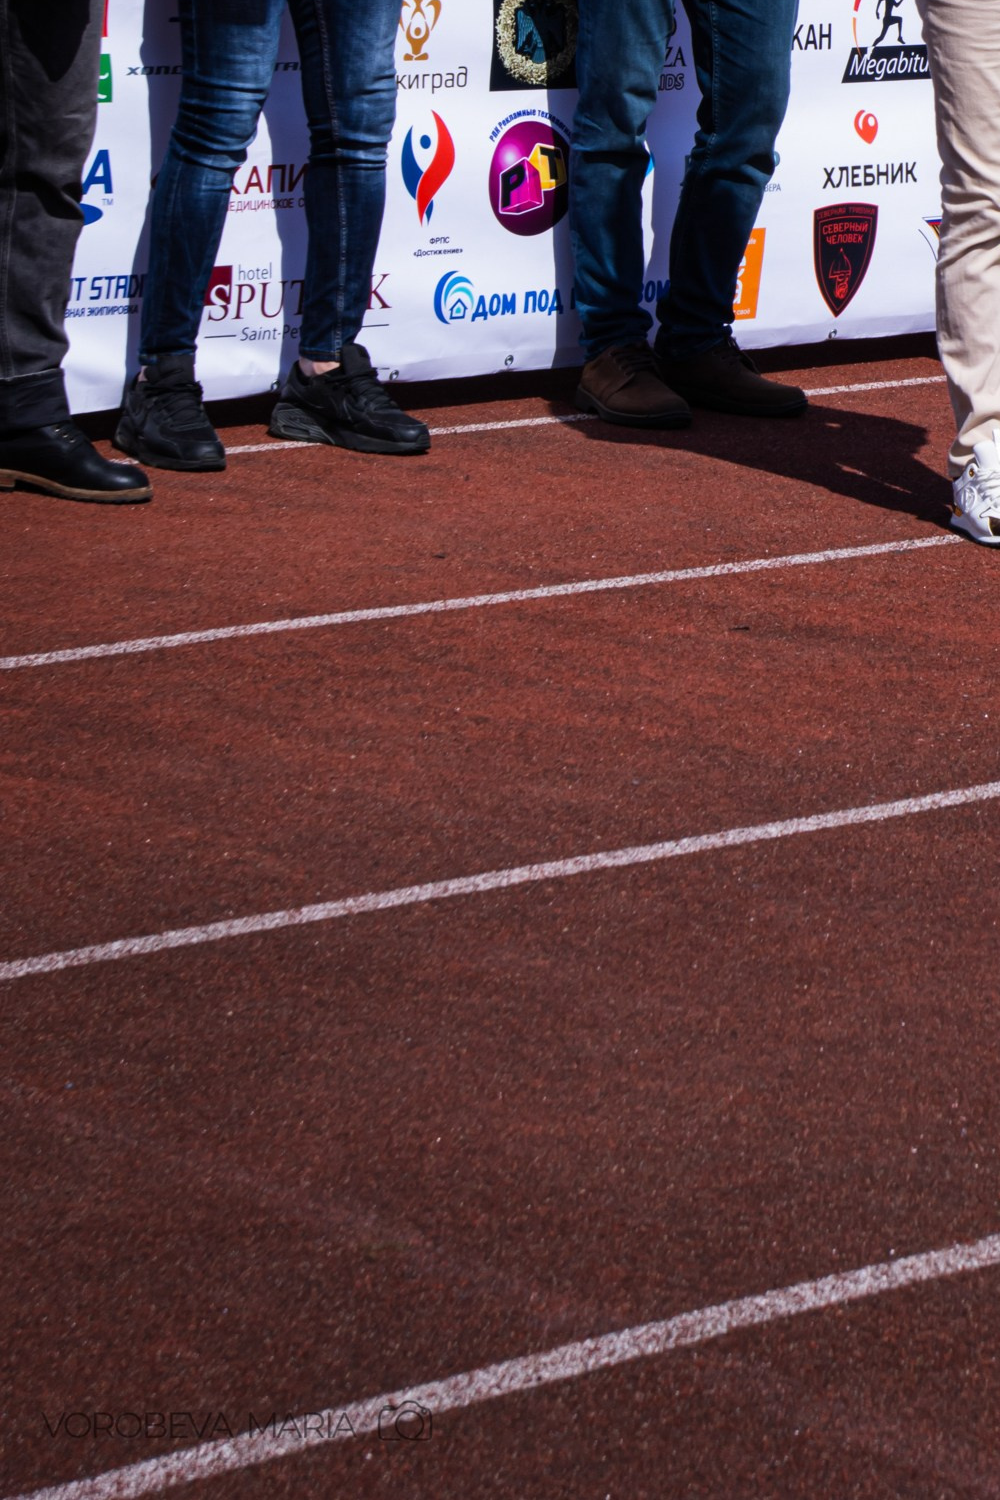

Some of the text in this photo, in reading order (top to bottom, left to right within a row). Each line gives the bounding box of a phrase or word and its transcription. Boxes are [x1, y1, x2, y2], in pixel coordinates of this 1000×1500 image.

[791, 23, 832, 51] КАН
[849, 51, 931, 81] Megabitu
[395, 66, 468, 94] киград
[657, 73, 685, 91] IDS
[498, 108, 537, 130] Рекламные
[822, 162, 918, 190] ХЛЕБНИК
[763, 183, 782, 193] ВЕРА
[228, 197, 294, 213] ЕДИЦИНСКОЕ
[822, 221, 869, 235] СЕВЕРНЫЙ
[429, 236, 450, 245] ФРПС
[826, 233, 863, 245] ЧЕЛОВЕК
[413, 247, 464, 257] «Достижение»
[238, 262, 272, 281] hotel
[90, 273, 145, 301] STADI
[86, 303, 139, 317] ЭКИПИРОВКА
[471, 292, 516, 322] ДОМ
[523, 289, 564, 316] ПОД
[240, 324, 302, 342] Saint-Pe
